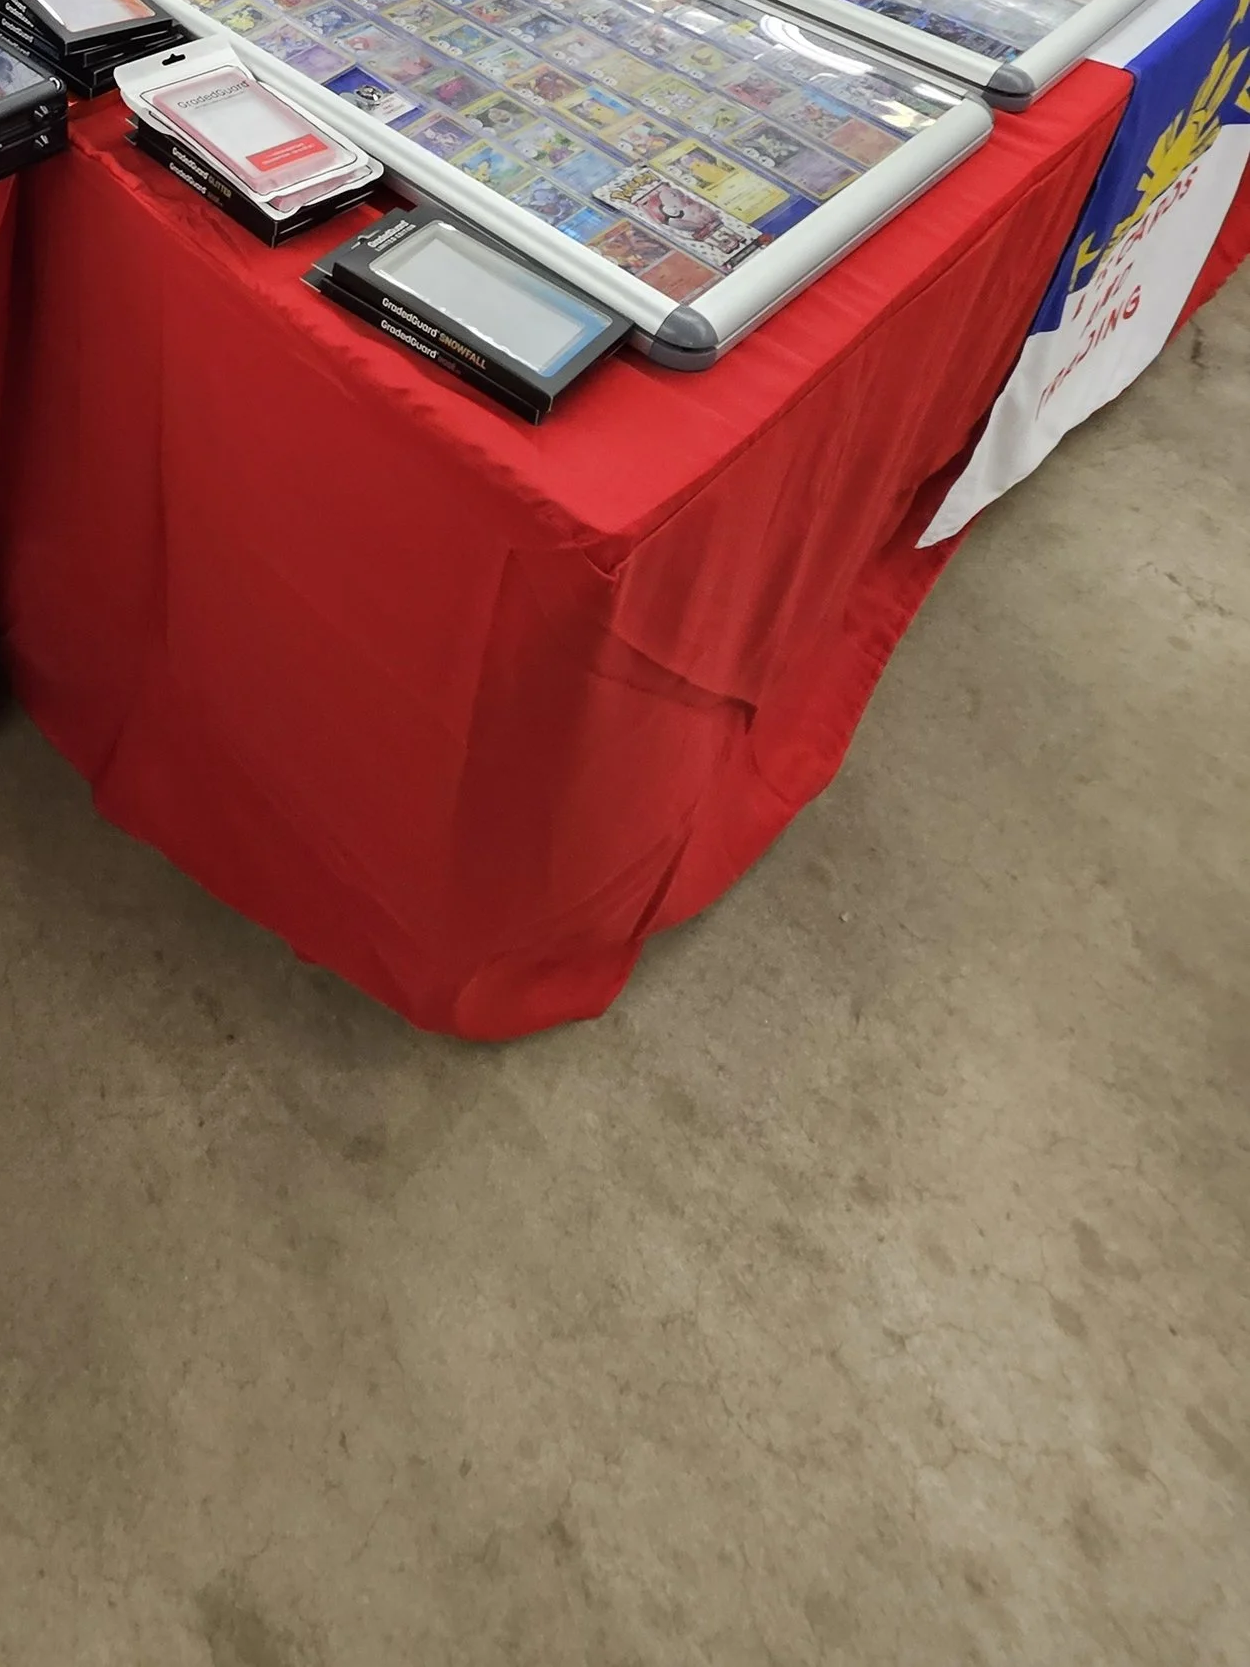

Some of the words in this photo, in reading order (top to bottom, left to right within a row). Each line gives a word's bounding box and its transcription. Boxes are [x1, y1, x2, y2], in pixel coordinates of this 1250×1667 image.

[177, 79, 250, 110] GradedGuard
[172, 146, 209, 180] GradedGuard
[380, 318, 439, 360] GradedGuard
[381, 296, 440, 338] GradedGuard
[439, 332, 487, 370] SNOWFALL
